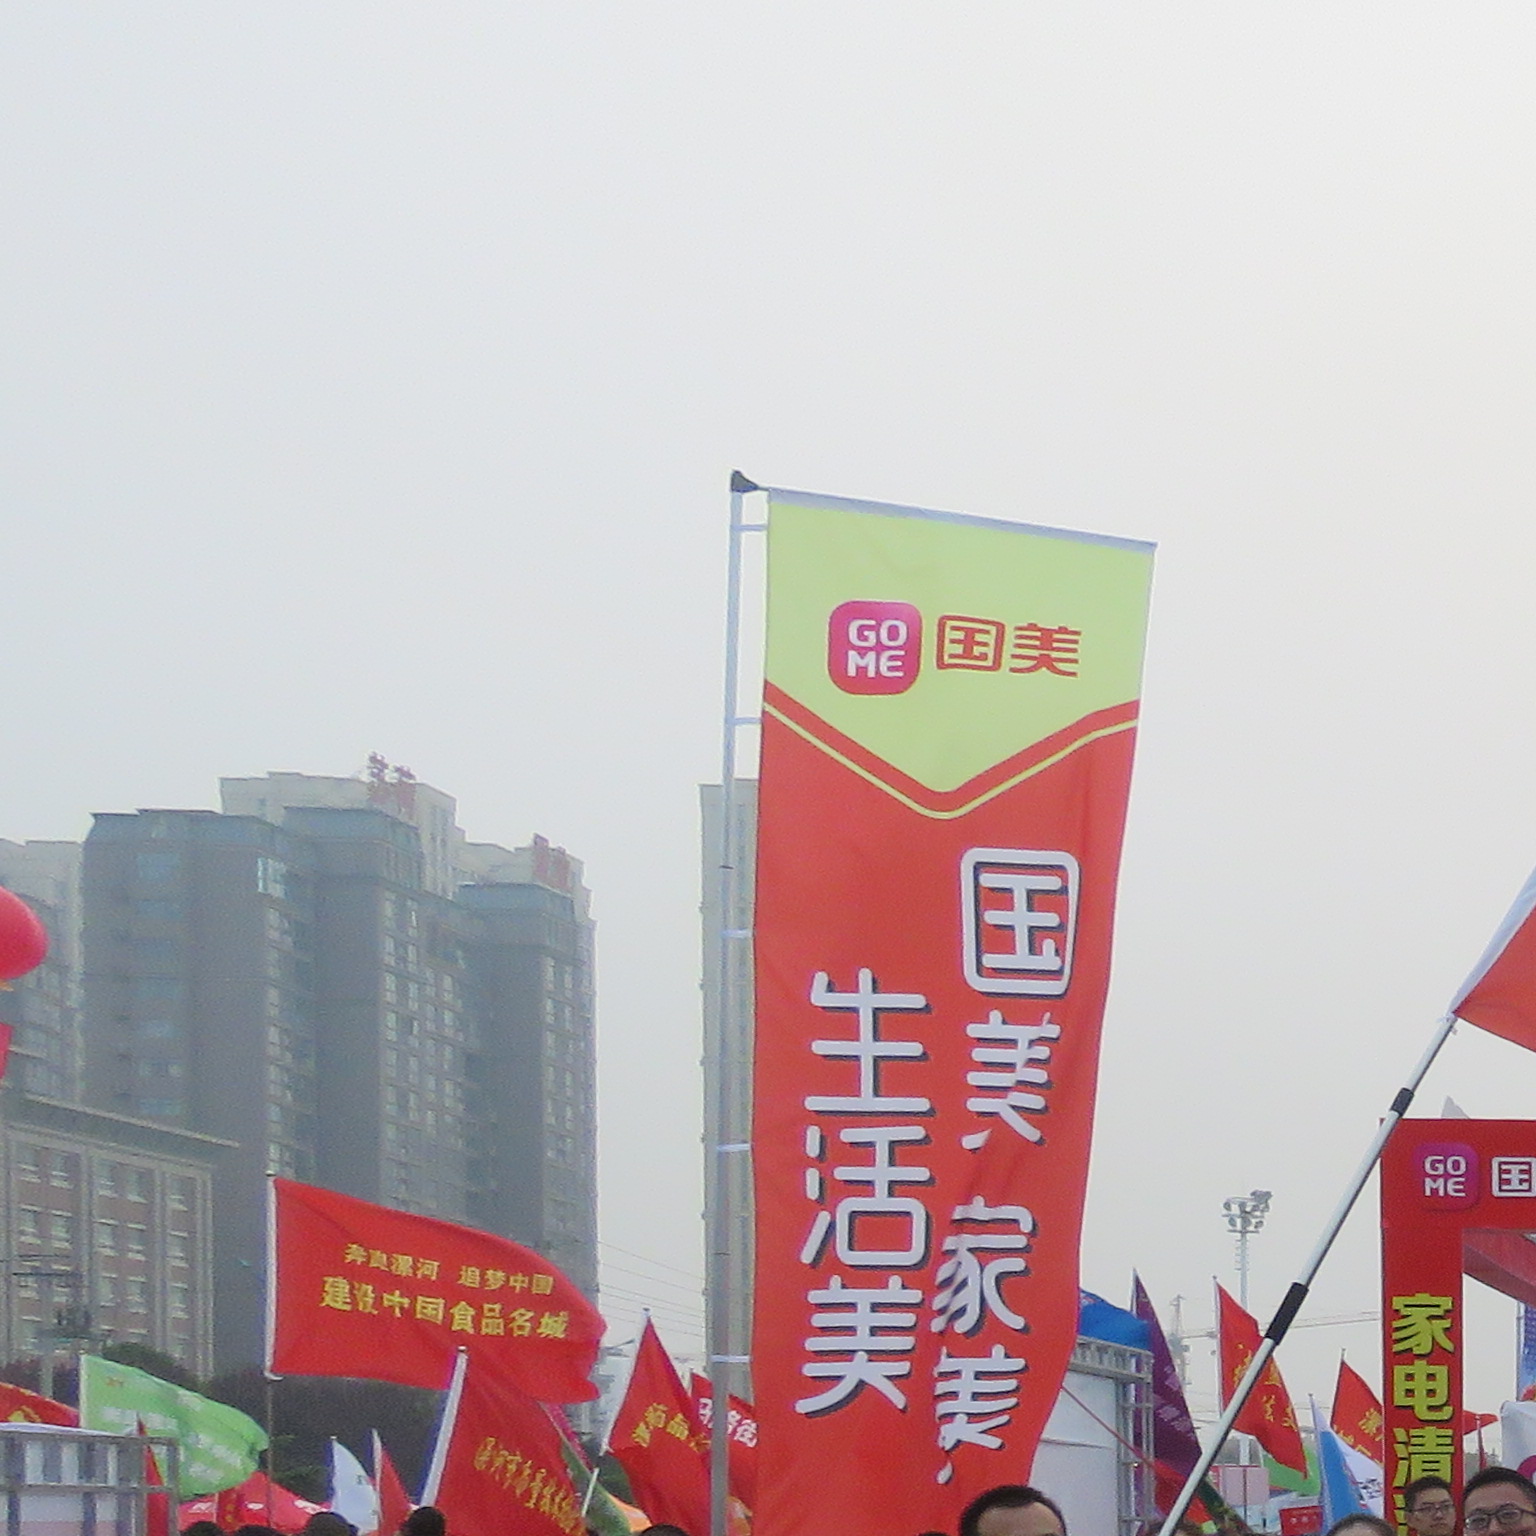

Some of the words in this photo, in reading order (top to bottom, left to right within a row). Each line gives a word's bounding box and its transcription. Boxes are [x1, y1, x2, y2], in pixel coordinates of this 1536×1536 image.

[846, 618, 910, 648] GO
[935, 615, 1083, 679] 国美
[846, 649, 906, 679] ME
[1423, 1155, 1467, 1176] GO
[795, 967, 937, 1418] 生活美
[1424, 1177, 1466, 1197] ME
